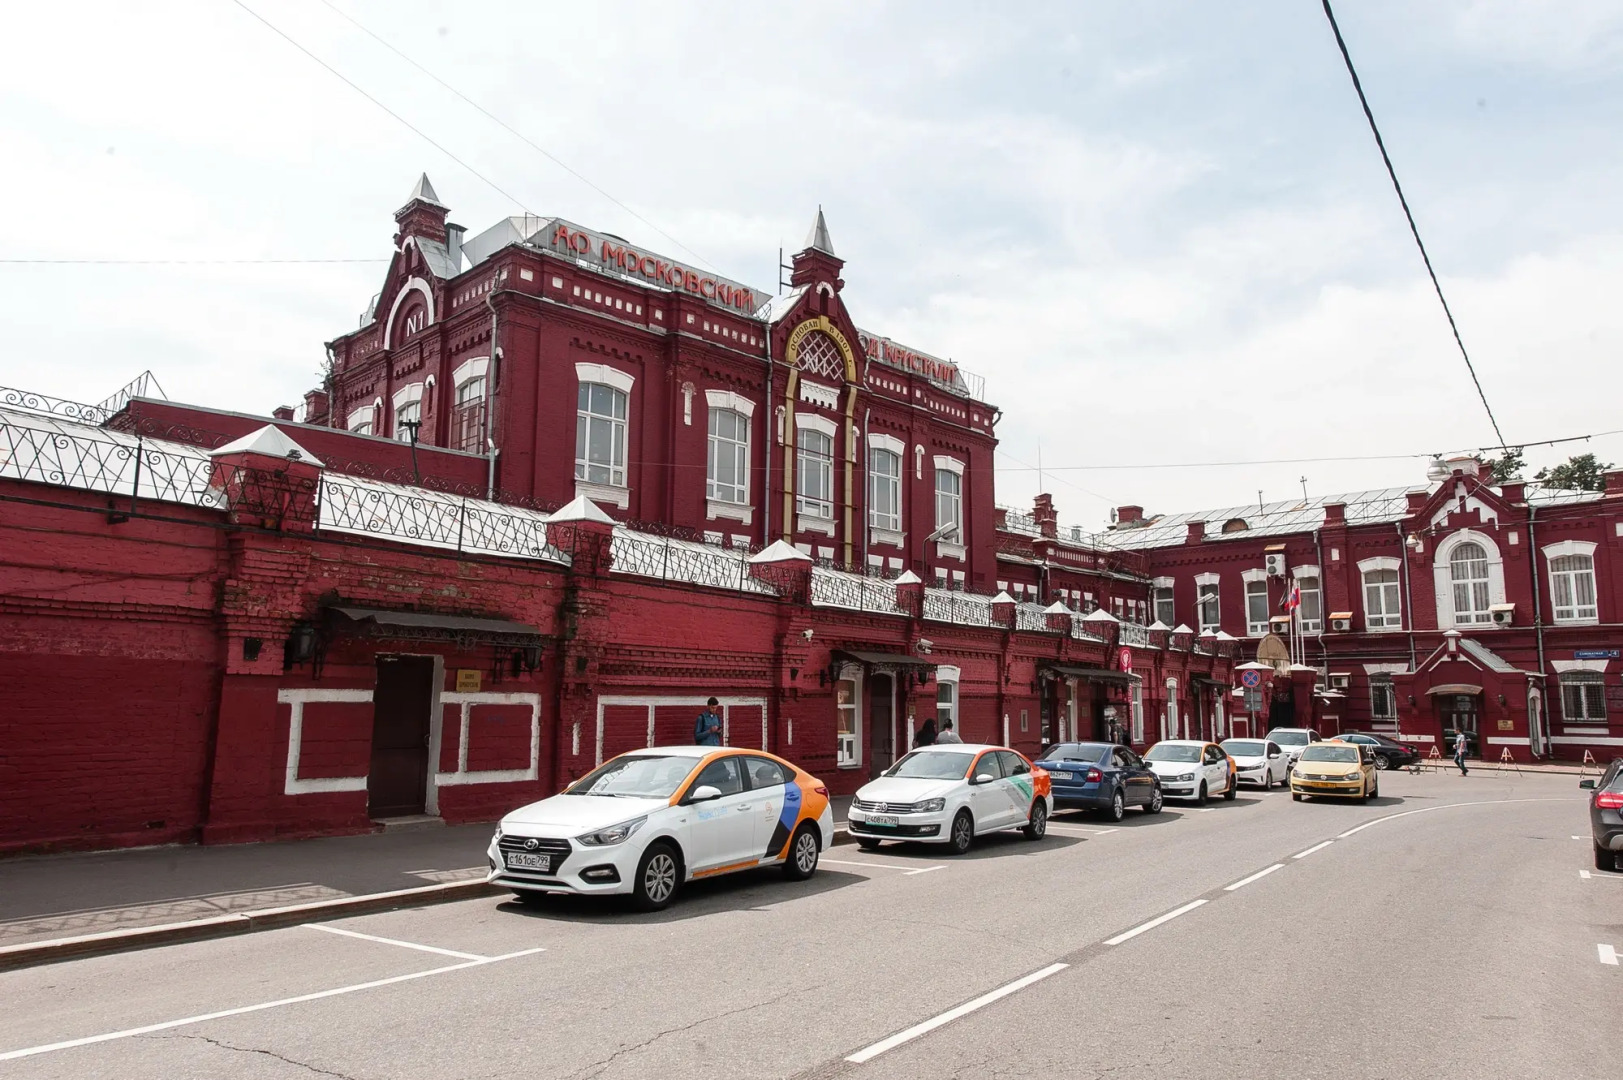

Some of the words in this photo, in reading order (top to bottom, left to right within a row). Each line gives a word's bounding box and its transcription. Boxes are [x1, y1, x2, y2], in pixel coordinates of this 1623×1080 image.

[552, 225, 591, 254] АО
[603, 240, 754, 309] МОСКОВСКИЙ
[790, 320, 819, 351] ОСНОВАН
[836, 332, 850, 353] 1901
